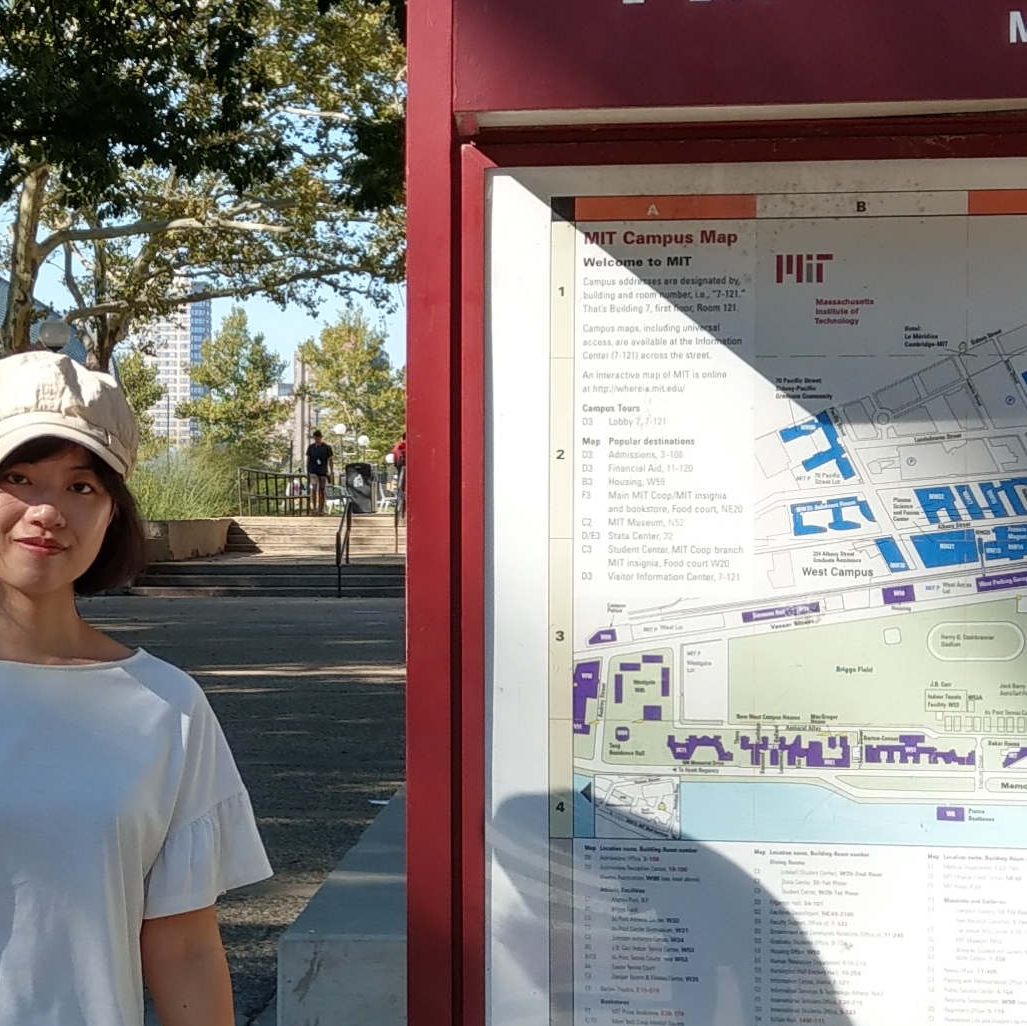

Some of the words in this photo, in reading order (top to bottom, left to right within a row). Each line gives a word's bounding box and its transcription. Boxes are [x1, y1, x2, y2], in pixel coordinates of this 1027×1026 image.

[1010, 11, 1027, 43] M
[647, 204, 658, 215] A
[856, 202, 866, 212] B
[584, 232, 616, 245] MIT
[623, 231, 693, 247] Campus
[700, 230, 737, 246] Map
[583, 257, 643, 267] Welcome
[648, 257, 662, 266] to
[667, 256, 692, 266] MIT
[776, 254, 833, 283] MIT
[583, 277, 616, 286] Campus
[619, 277, 661, 285] addresses
[680, 276, 726, 286] designated
[559, 286, 564, 296] 1
[583, 291, 615, 300] building
[660, 290, 692, 299] number,
[610, 304, 643, 314] Building
[646, 304, 652, 313] 7,
[655, 304, 671, 312] first
[674, 304, 694, 313] floor,
[723, 303, 739, 312] 121.
[583, 324, 615, 333] Campus
[644, 324, 680, 333] including
[683, 323, 720, 332] universal
[631, 338, 667, 346] available
[696, 337, 742, 345] Information
[611, 351, 638, 360] (7-121)
[670, 351, 683, 359] the
[582, 371, 593, 379] An
[596, 370, 640, 379] interactive
[643, 372, 660, 380] map
[663, 370, 670, 378] of
[674, 370, 690, 378] MIT
[702, 370, 727, 378] online
[582, 404, 615, 413] Campus
[582, 438, 600, 447] Map
[608, 438, 641, 447] Popular
[643, 437, 695, 445] destinations
[556, 450, 565, 459] 2
[608, 572, 634, 580] Visitor
[637, 572, 684, 581] Information
[687, 572, 716, 582] Center,
[802, 567, 828, 576] West
[831, 567, 873, 577] Campus
[556, 631, 564, 641] 3
[556, 802, 565, 812] 4
